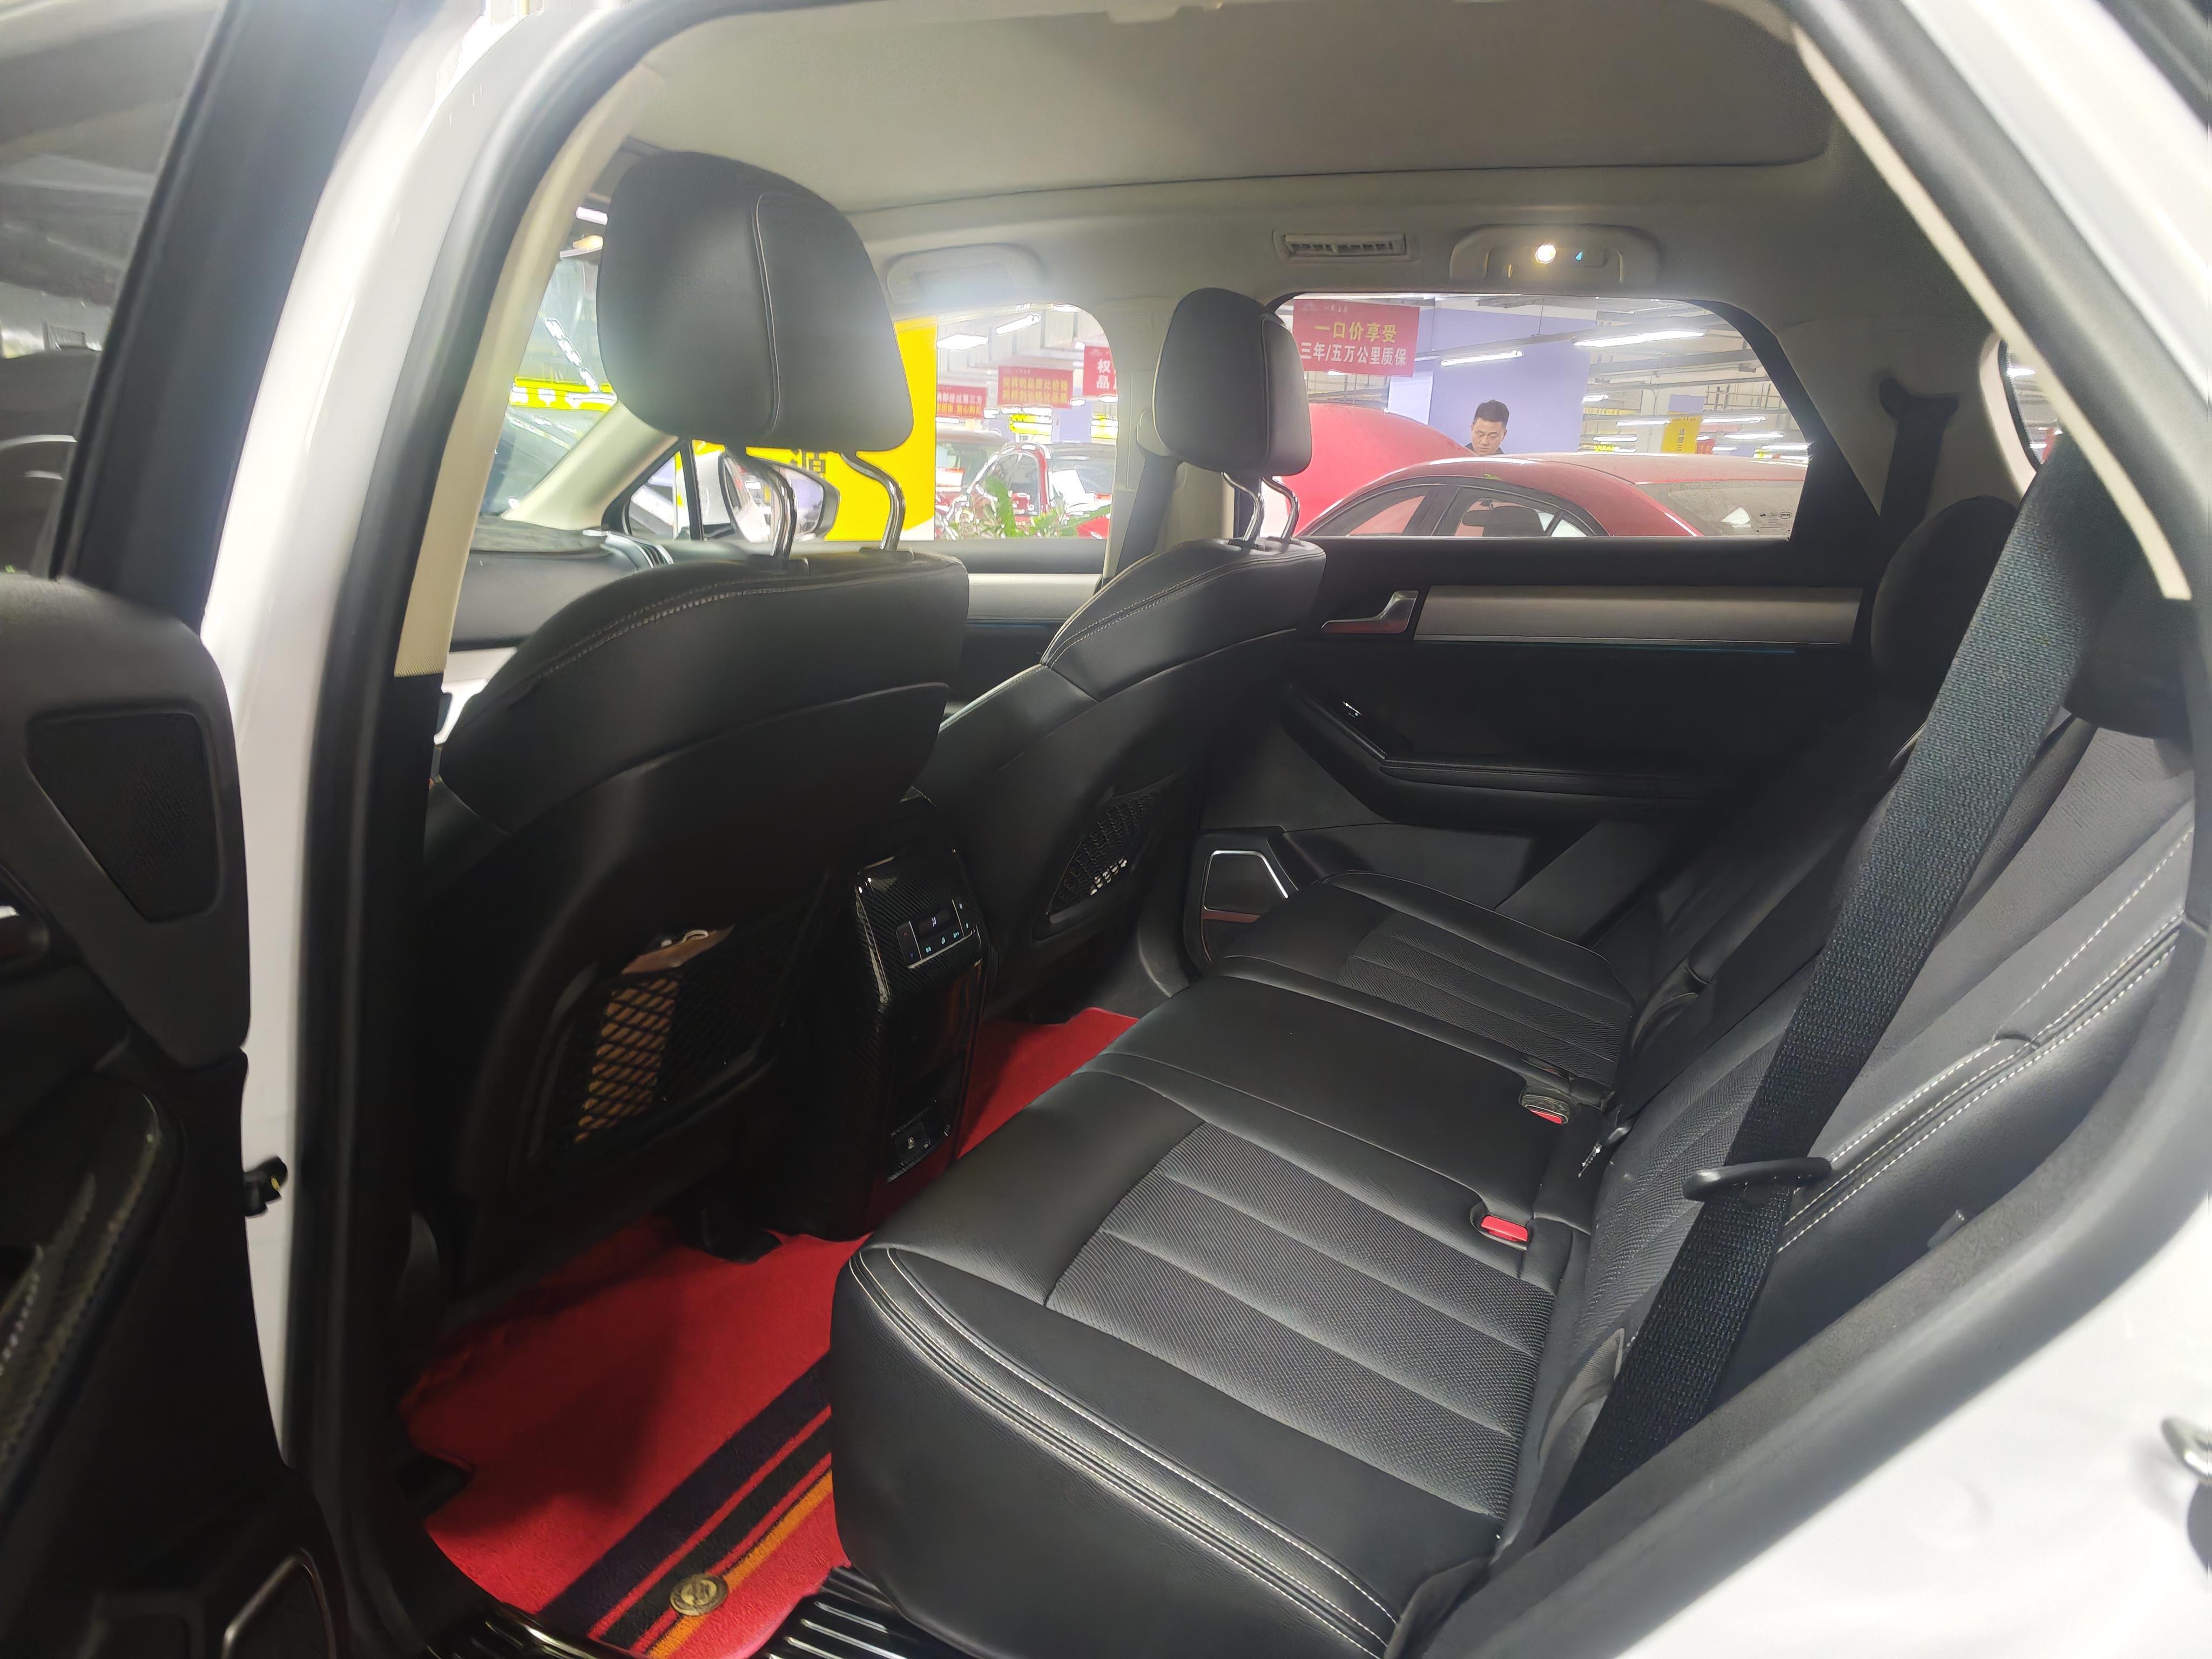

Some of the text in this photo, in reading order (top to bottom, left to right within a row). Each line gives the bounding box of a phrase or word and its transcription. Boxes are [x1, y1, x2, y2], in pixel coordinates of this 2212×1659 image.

[1314, 321, 1397, 343] 一口价享受
[1300, 342, 1407, 366] 三年/五万公里质保
[1096, 374, 1117, 390] 品
